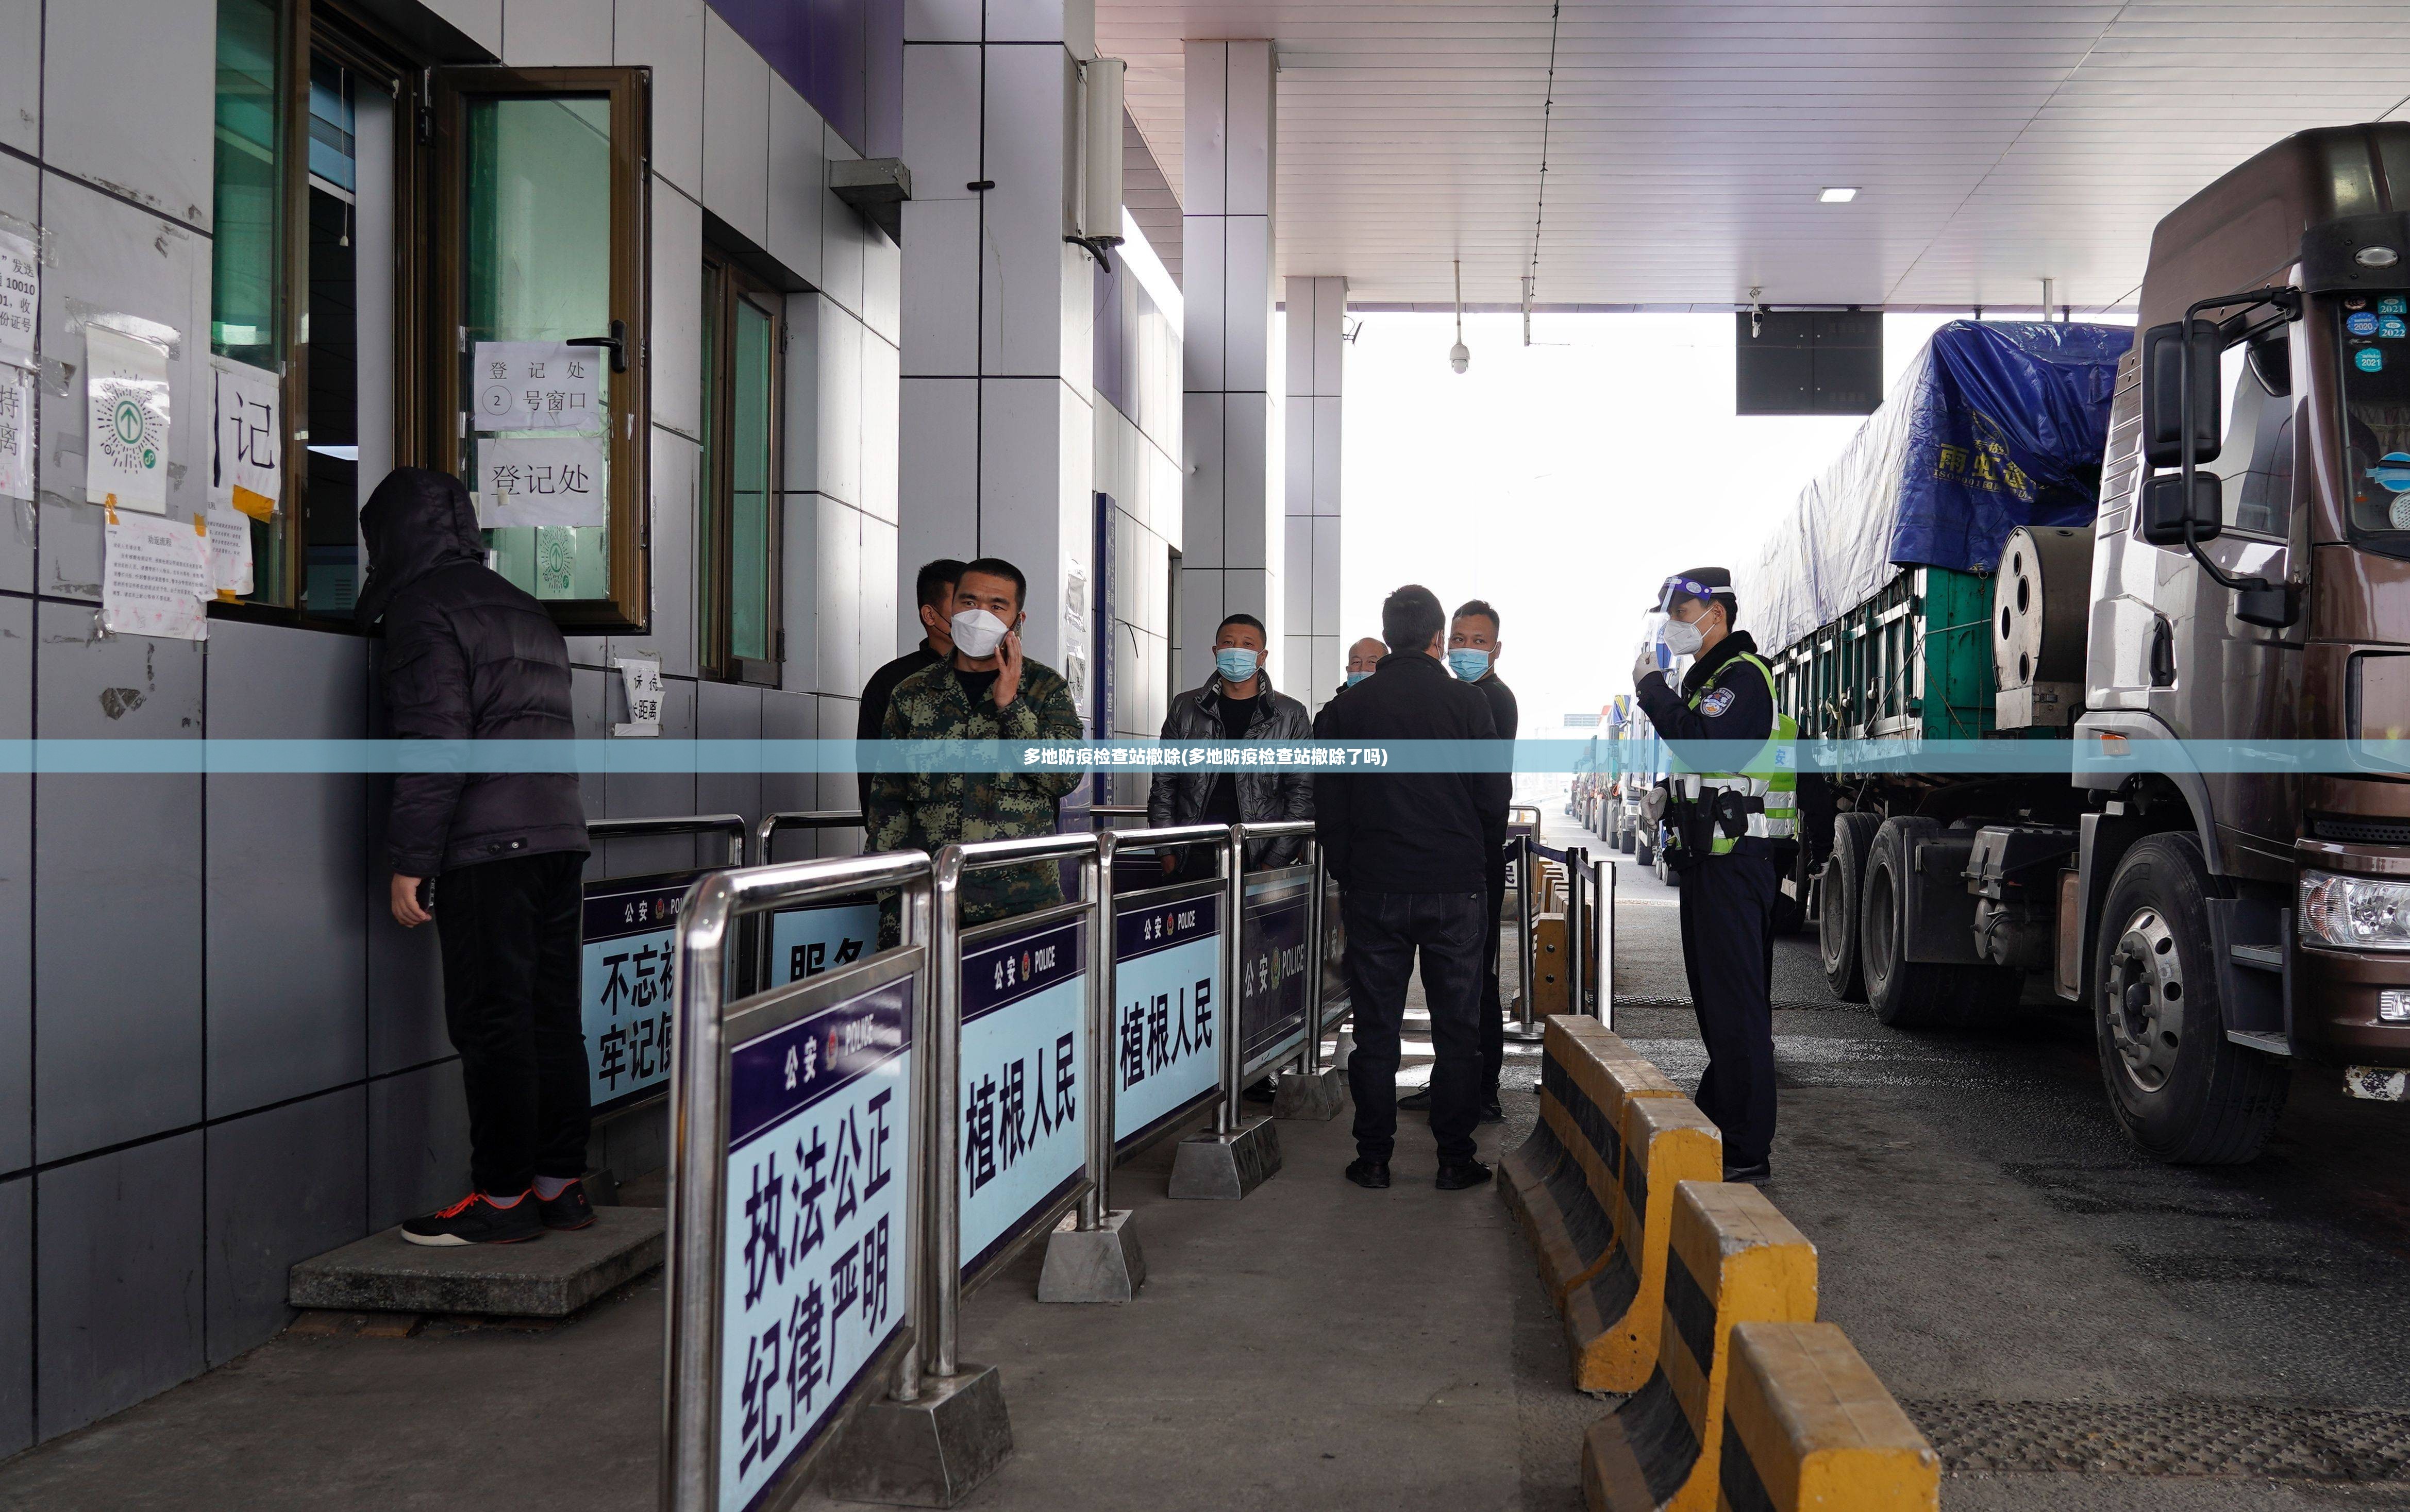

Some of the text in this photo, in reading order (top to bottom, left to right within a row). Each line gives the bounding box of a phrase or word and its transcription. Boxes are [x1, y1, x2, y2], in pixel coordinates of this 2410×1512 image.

[7, 277, 35, 296] 10010
[2354, 323, 2373, 331] 2020
[2380, 305, 2403, 313] 2021
[2382, 329, 2406, 337] 2022
[230, 392, 275, 469] 记
[491, 464, 590, 495] 登记处
[1775, 749, 1786, 765] 安
[625, 900, 648, 923] 公安
[1144, 910, 1196, 940] 公安 POLICE
[994, 945, 1056, 990] 公安 POLICE
[1245, 944, 1304, 998] 公安 POLICE
[784, 1013, 874, 1091] 公安 POLICE
[1120, 978, 1212, 1093] 植根人民
[965, 1031, 1076, 1199] 植根人民
[744, 1086, 892, 1314] 执法公正
[739, 1212, 890, 1483] 纪律严明
